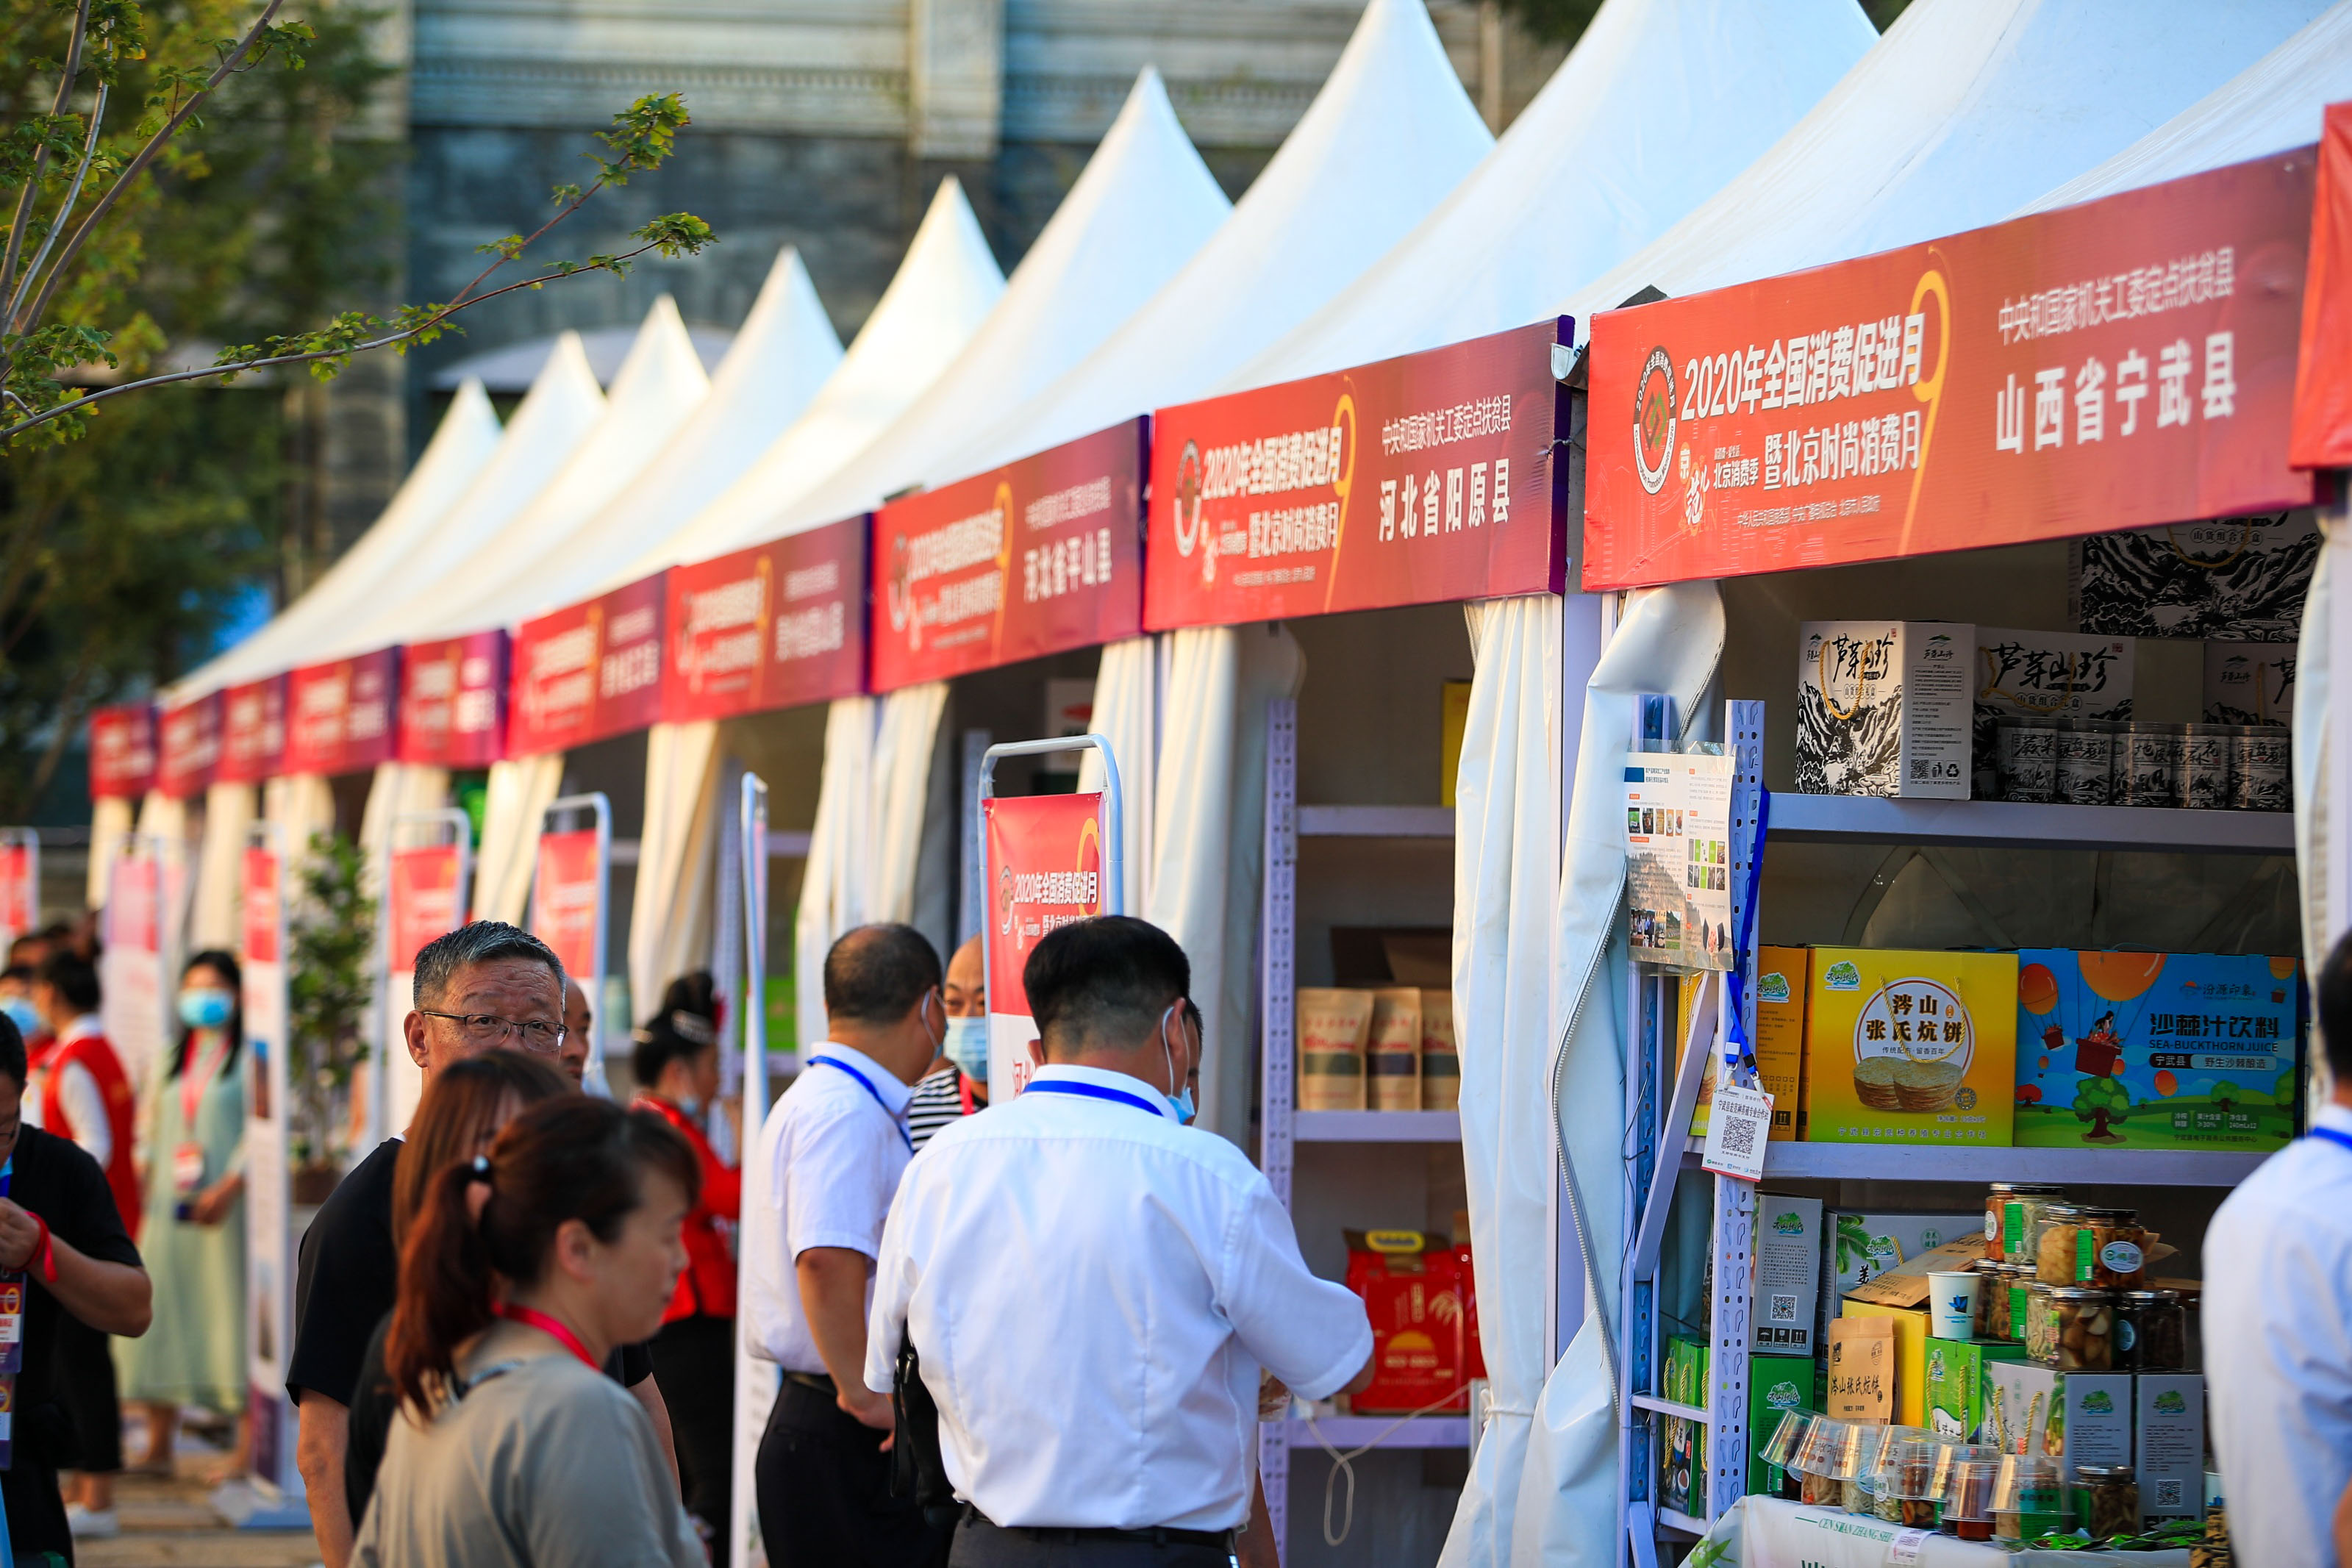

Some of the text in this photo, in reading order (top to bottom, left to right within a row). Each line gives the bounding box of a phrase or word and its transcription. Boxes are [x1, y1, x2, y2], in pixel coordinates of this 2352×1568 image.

[1998, 246, 2235, 346] 中央和国家机关工委定点扶贫县
[1680, 312, 1925, 421] 2020年全国消费促进月
[1995, 331, 2237, 454] 山西省宁武县
[1381, 393, 1512, 457] 中央和国家机关工委定点扶贫县
[1763, 411, 1922, 490] 暨北京时尚消费月
[1713, 457, 1759, 490] 北京消费季
[1379, 457, 1511, 543] 河北省阳原县
[1014, 870, 1098, 905] 2020年全国消费促进月
[2149, 1013, 2279, 1039] 沙棘汁饮料
[2148, 1039, 2279, 1052] SEA-BUCKTHORN JUICE
[2155, 1056, 2187, 1067] 宁武县
[2204, 1056, 2267, 1069] 野生沙棘酿造
[1852, 1525, 1880, 1541] ZHANG
